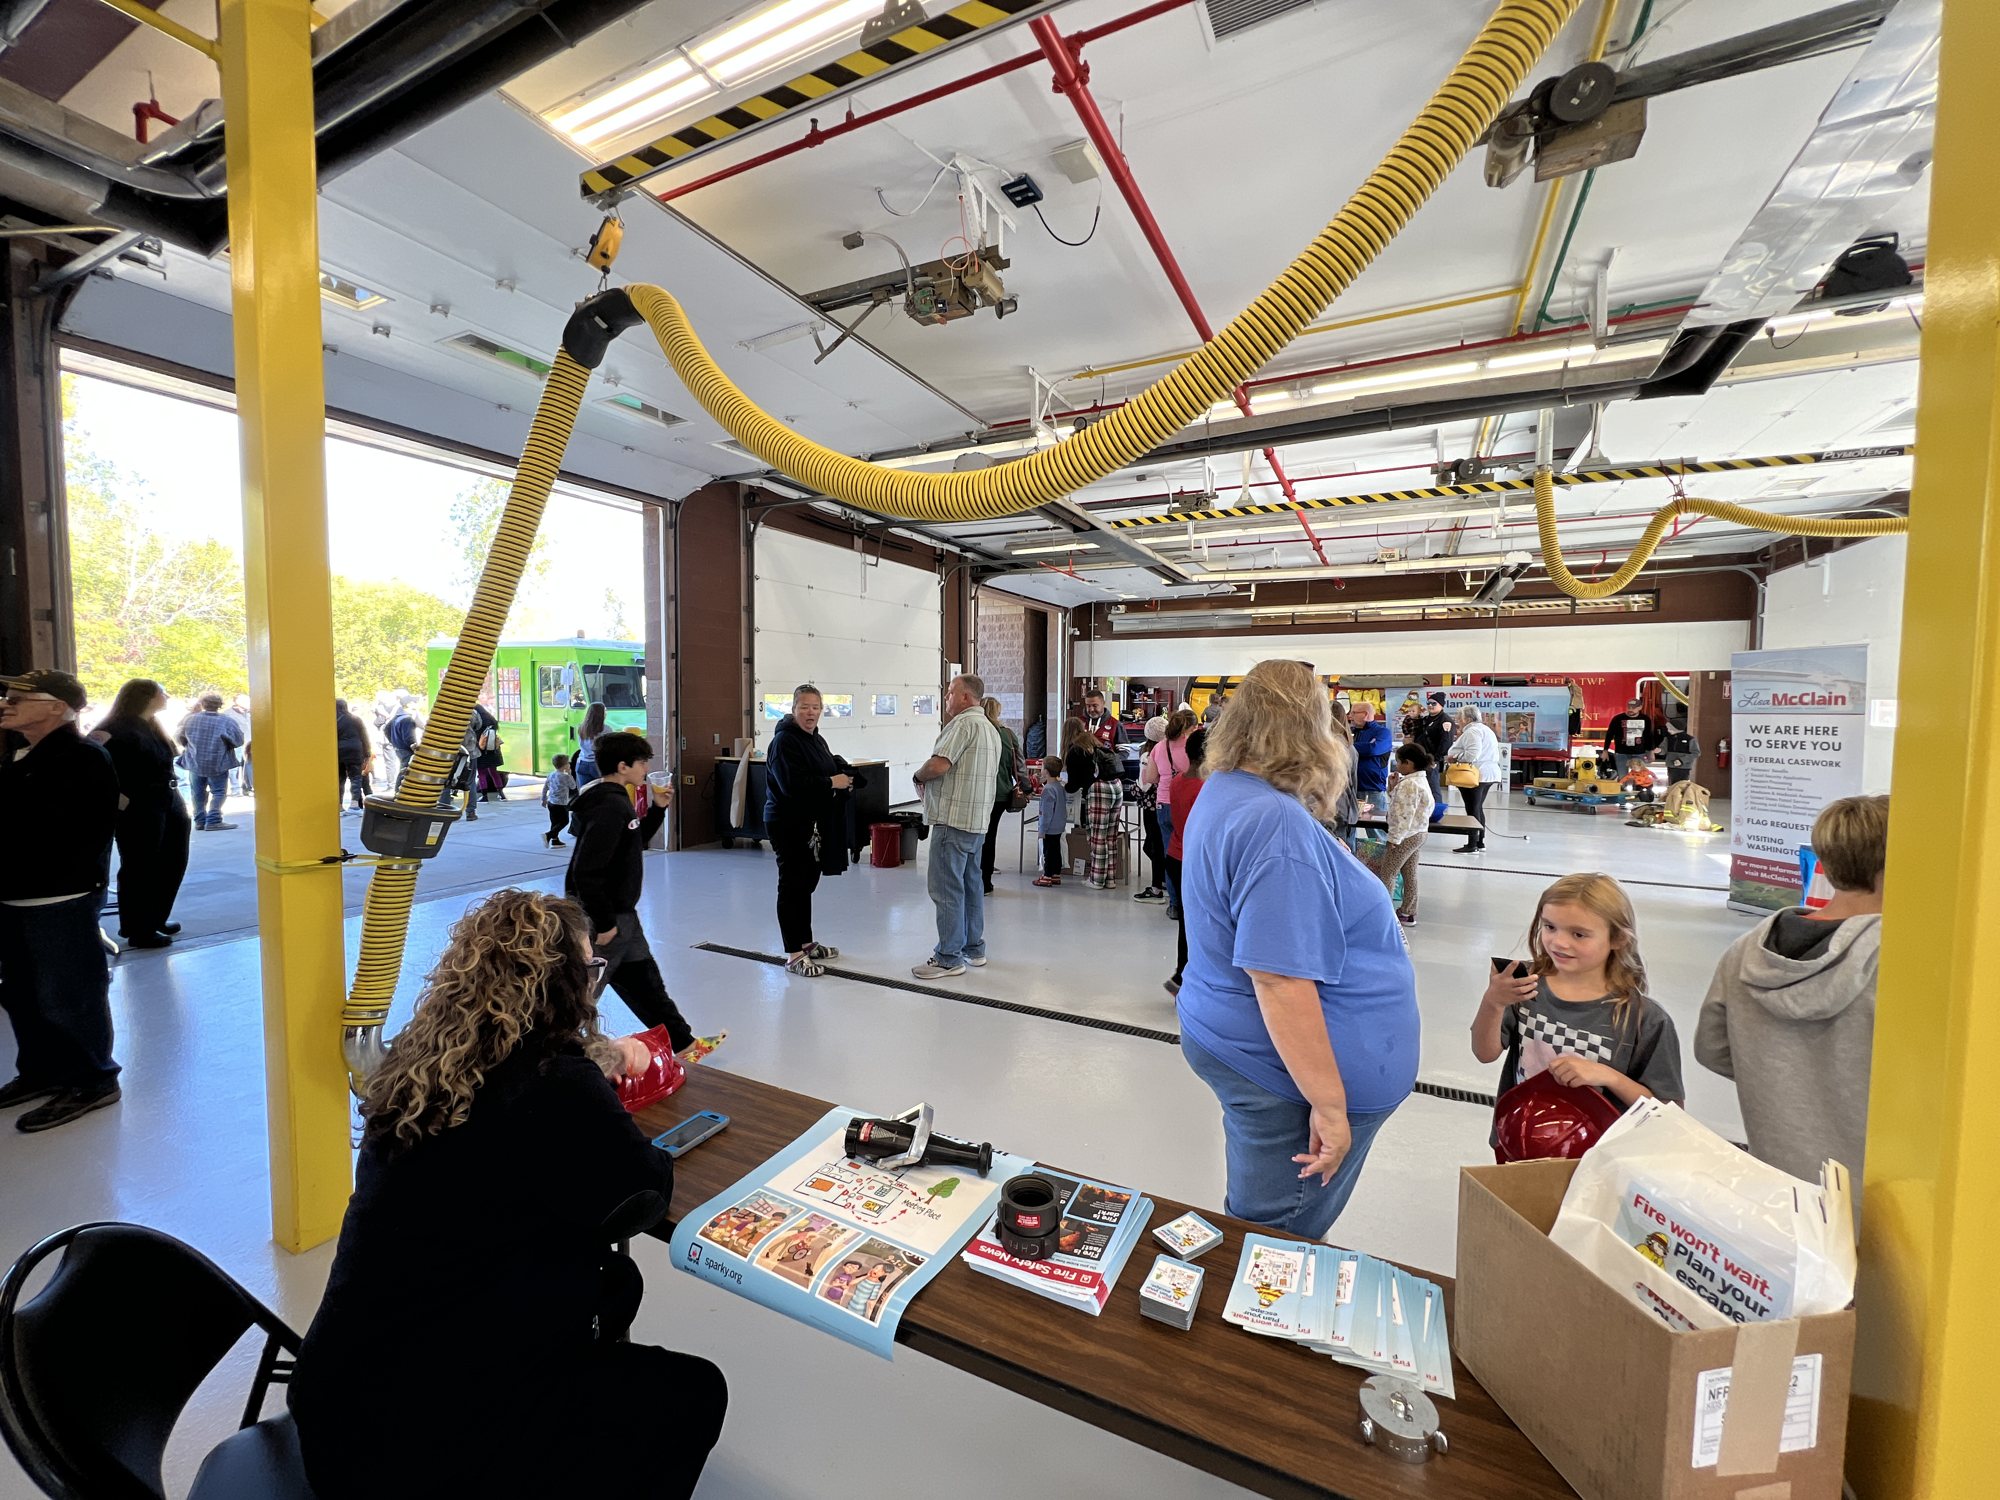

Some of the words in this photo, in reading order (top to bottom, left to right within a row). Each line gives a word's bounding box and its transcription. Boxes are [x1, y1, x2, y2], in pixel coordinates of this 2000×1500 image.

[1449, 691, 1481, 699] won't
[1483, 690, 1511, 699] wait.
[1446, 700, 1463, 708] lan
[1494, 700, 1540, 710] escape.
[1737, 692, 1771, 708] Lisa
[1771, 692, 1847, 706] McClain
[759, 701, 764, 712] 3
[1749, 725, 1771, 734] WE
[1774, 725, 1800, 735] ARE
[1804, 726, 1839, 736] HERE
[1745, 739, 1762, 748] TO
[1766, 739, 1807, 750] SERVE
[1811, 741, 1842, 752] YOU
[1749, 756, 1785, 765] FEDERAL
[1787, 758, 1841, 768] CASEWORK
[1746, 817, 1768, 826] FLAG
[1747, 834, 1784, 845] VISITING
[1749, 862, 1768, 870] more
[1092, 1213, 1100, 1221] is
[1097, 1209, 1120, 1218] dark!
[1101, 1214, 1118, 1223] Fire
[1073, 1248, 1081, 1256] is
[1081, 1244, 1102, 1253] fast!
[1633, 1193, 1667, 1226] Fire
[1670, 1220, 1721, 1264] won't
[1723, 1257, 1773, 1302] wait.
[978, 1245, 1012, 1262] News
[1082, 1249, 1100, 1259] Fire
[704, 1257, 743, 1285] sparky.org
[1052, 1267, 1078, 1281] Fire
[1673, 1241, 1716, 1283] Plan
[1717, 1277, 1770, 1317] your
[1243, 1310, 1261, 1319] your
[1262, 1315, 1280, 1323] Plan
[1250, 1318, 1272, 1326] won't
[1273, 1322, 1289, 1330] Fire
